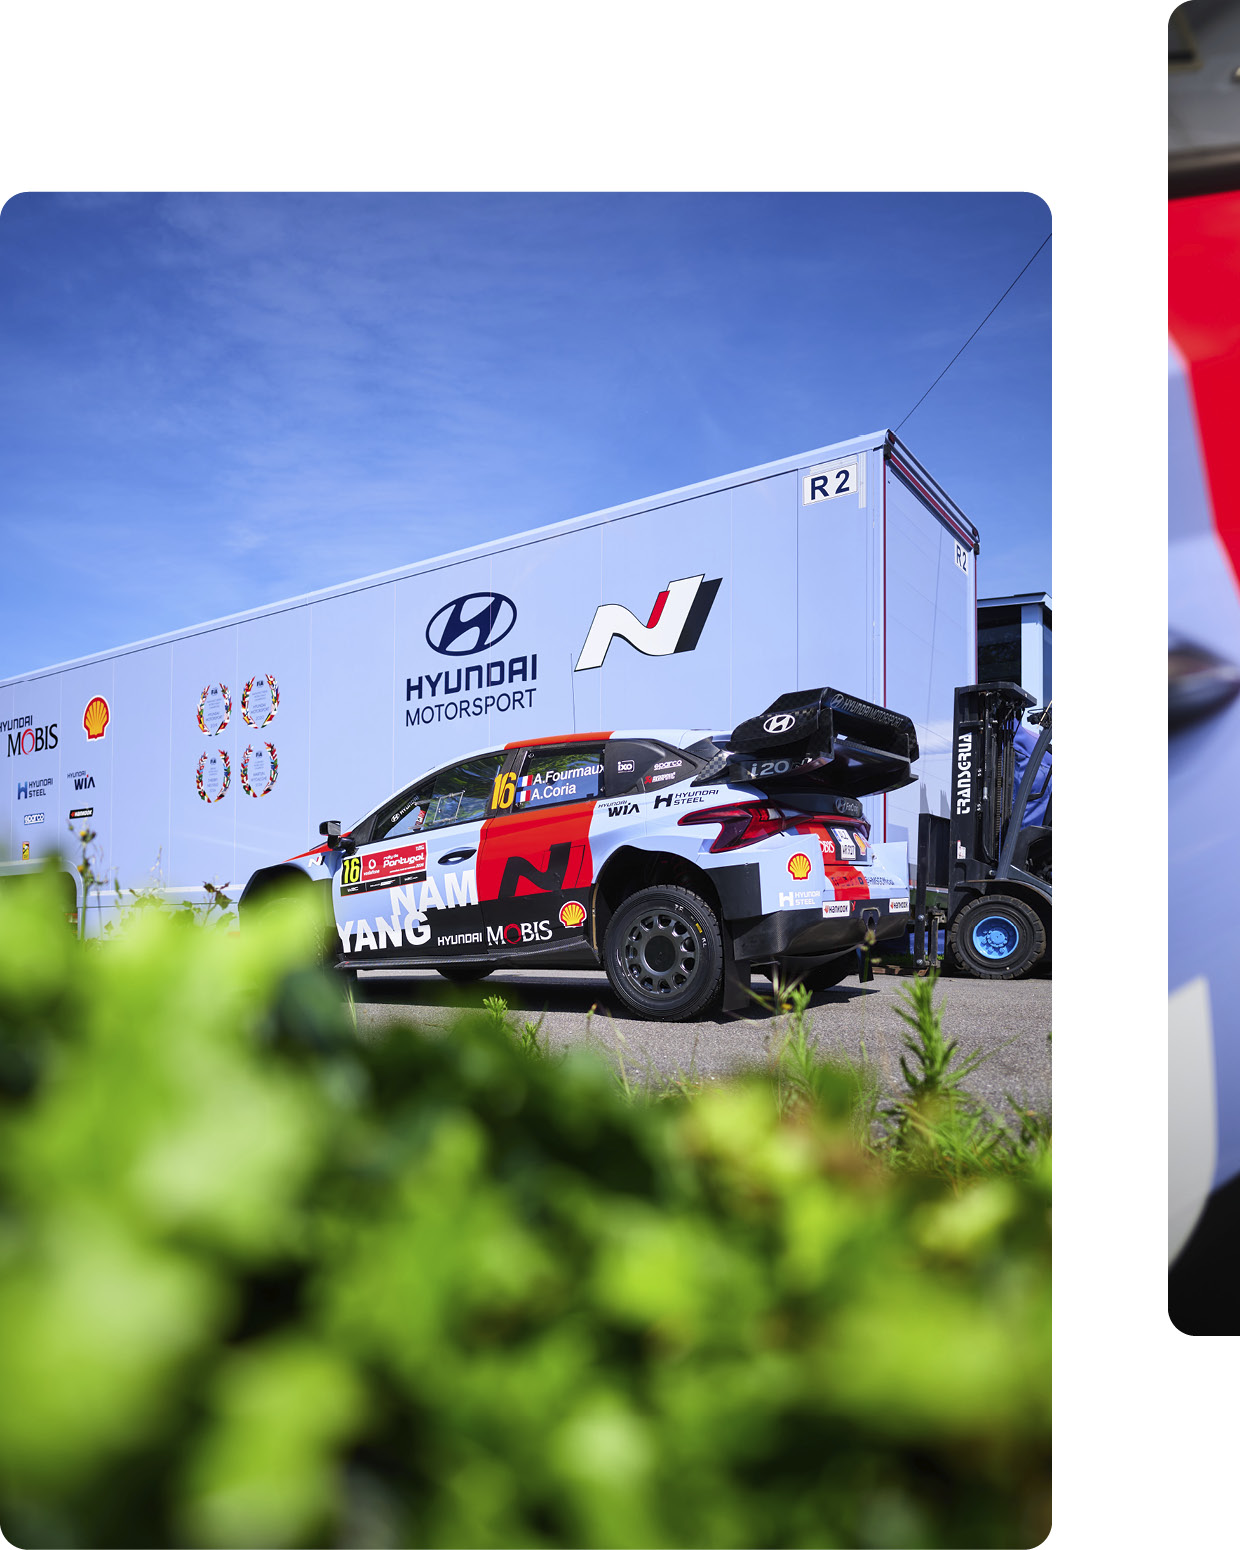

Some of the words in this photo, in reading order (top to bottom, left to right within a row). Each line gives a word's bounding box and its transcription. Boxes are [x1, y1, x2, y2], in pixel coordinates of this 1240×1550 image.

[811, 475, 830, 500] R
[835, 469, 850, 494] 2
[406, 654, 537, 701] HYUNDAI
[405, 688, 537, 727] MOTORSPORT
[7, 723, 58, 757] MOBIS
[532, 764, 605, 786] A.Fourmaux
[751, 760, 790, 777] i20
[28, 778, 53, 789] HYUNDAI
[74, 774, 95, 790] WIA
[491, 771, 516, 810] 16
[28, 788, 46, 798] STEEL
[531, 783, 577, 801] A.Coria
[673, 796, 705, 806] STEEL
[674, 789, 719, 799] HYUNDAI
[598, 800, 628, 808] HYUNDAI
[608, 802, 640, 817] WIA
[383, 853, 424, 868] Portugal
[344, 858, 360, 884] 16
[389, 869, 479, 916] NAM
[336, 911, 432, 954] YANG
[437, 932, 482, 947] HYUNDAI
[486, 920, 553, 946] MOBIS
